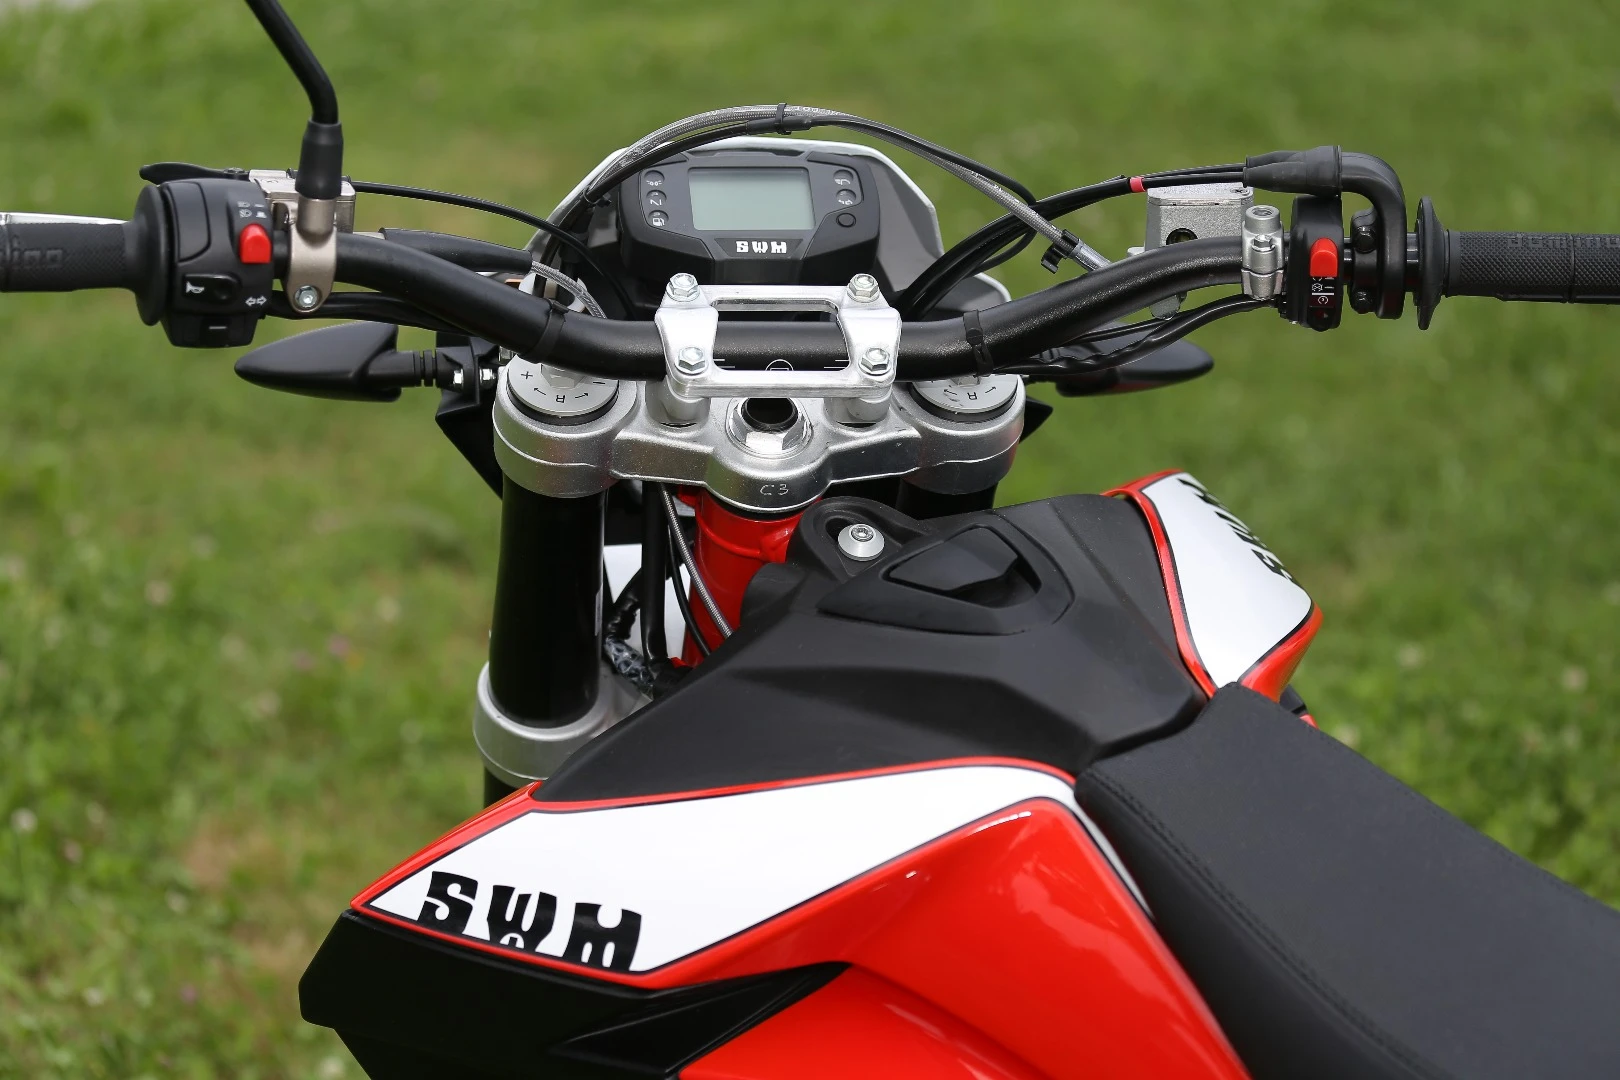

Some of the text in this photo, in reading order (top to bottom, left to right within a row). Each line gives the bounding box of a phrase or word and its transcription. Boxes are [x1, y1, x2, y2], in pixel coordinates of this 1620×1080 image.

[735, 240, 787, 254] SWM
[555, 394, 566, 404] R
[416, 870, 643, 972] SWM
